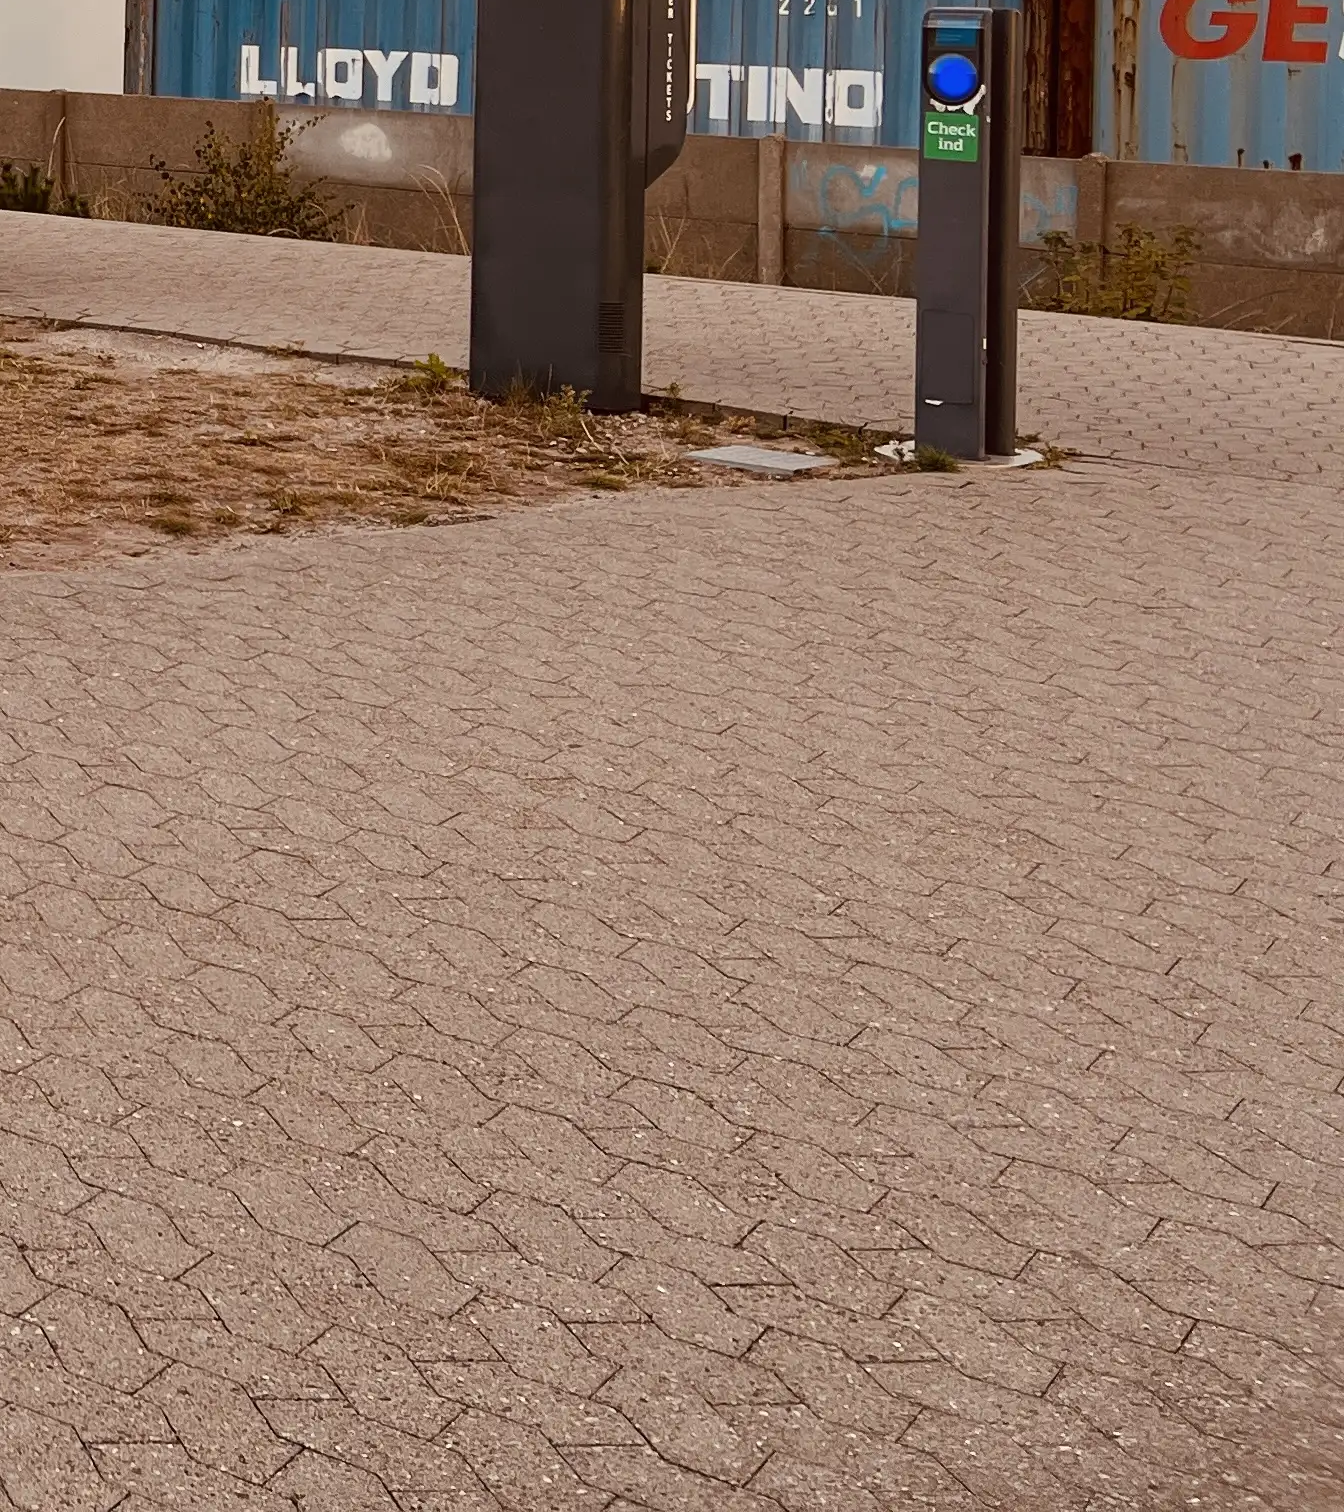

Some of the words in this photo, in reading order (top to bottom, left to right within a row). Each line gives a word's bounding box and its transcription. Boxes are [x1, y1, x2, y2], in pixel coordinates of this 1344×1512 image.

[240, 44, 460, 107] LLOYD
[665, 33, 674, 122] TICKETS
[927, 121, 977, 138] Check
[938, 137, 964, 152] ind
